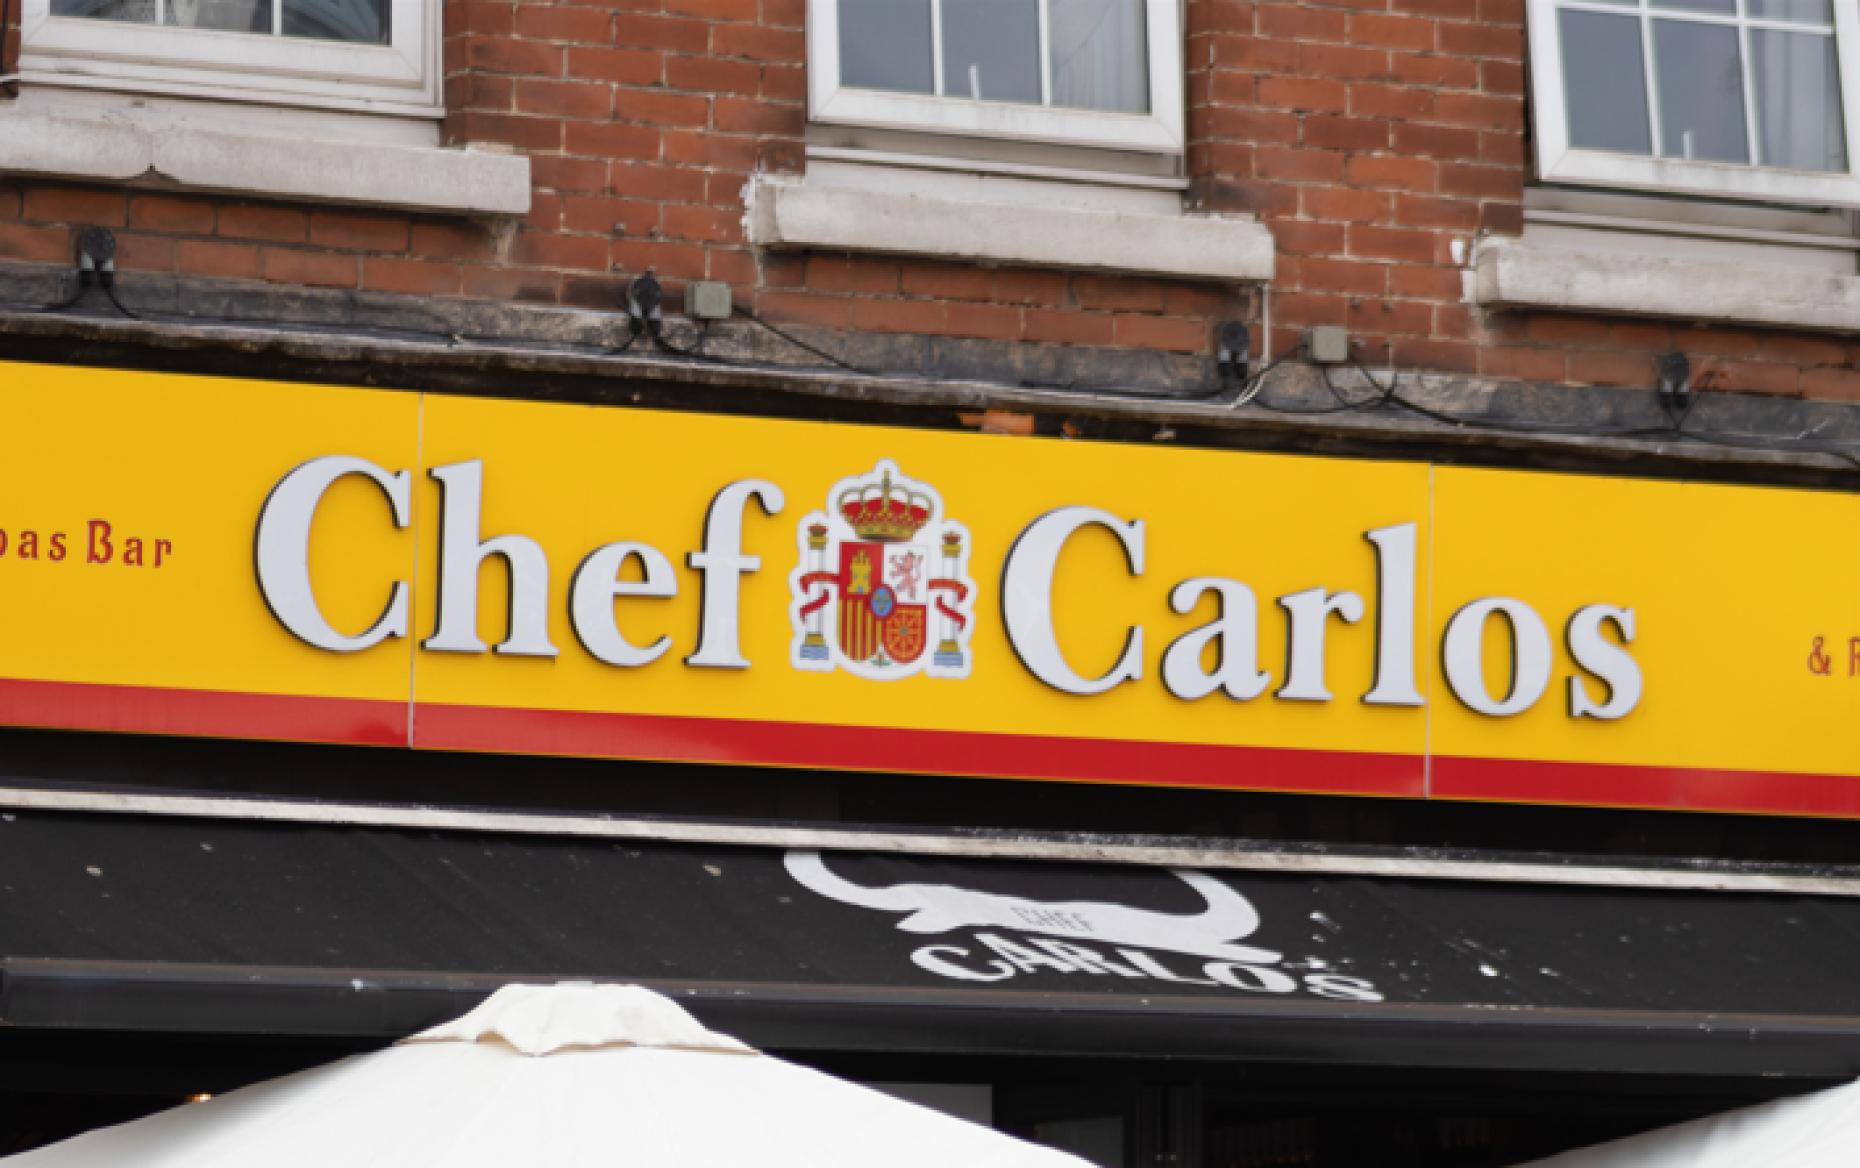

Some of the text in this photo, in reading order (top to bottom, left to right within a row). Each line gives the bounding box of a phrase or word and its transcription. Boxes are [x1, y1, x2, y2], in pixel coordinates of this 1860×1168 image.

[87, 519, 172, 568] Bar
[253, 455, 1644, 720] Chef Carlos
[1808, 636, 1831, 676] &
